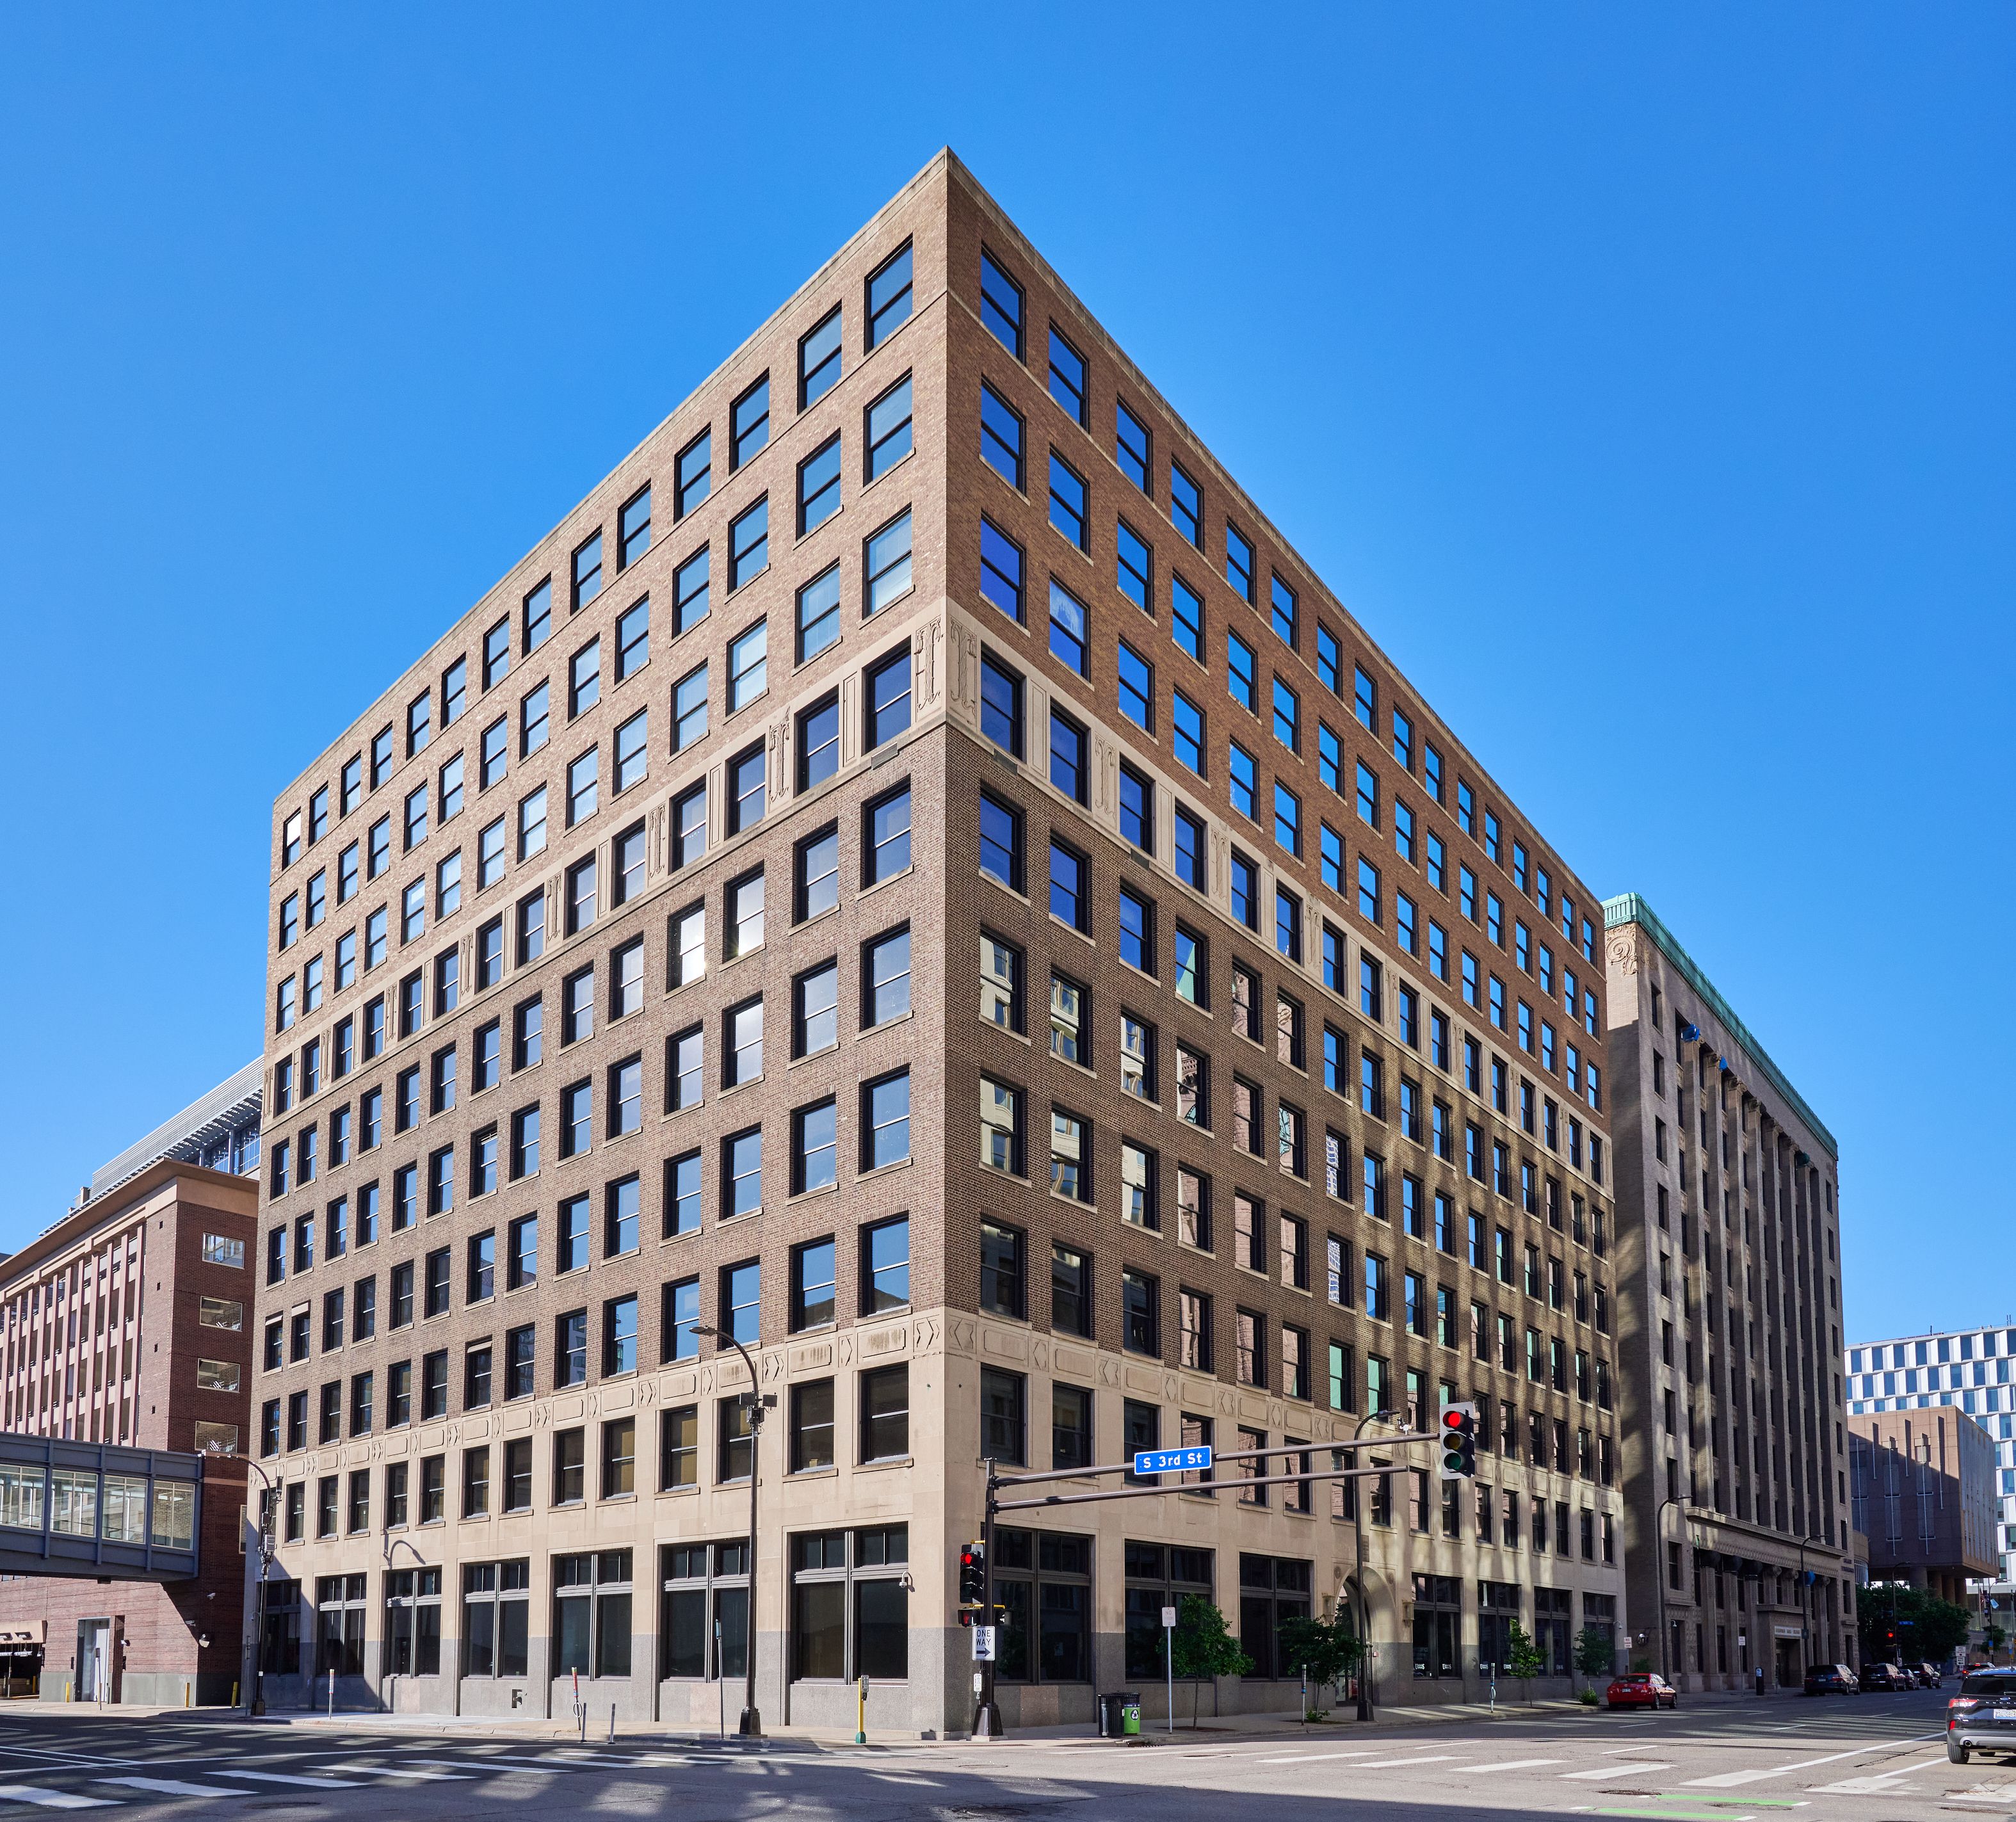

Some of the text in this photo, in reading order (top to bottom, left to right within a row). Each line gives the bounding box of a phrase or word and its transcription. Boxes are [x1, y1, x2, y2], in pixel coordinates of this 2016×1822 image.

[1143, 1453, 1202, 1469] S 3rd St
